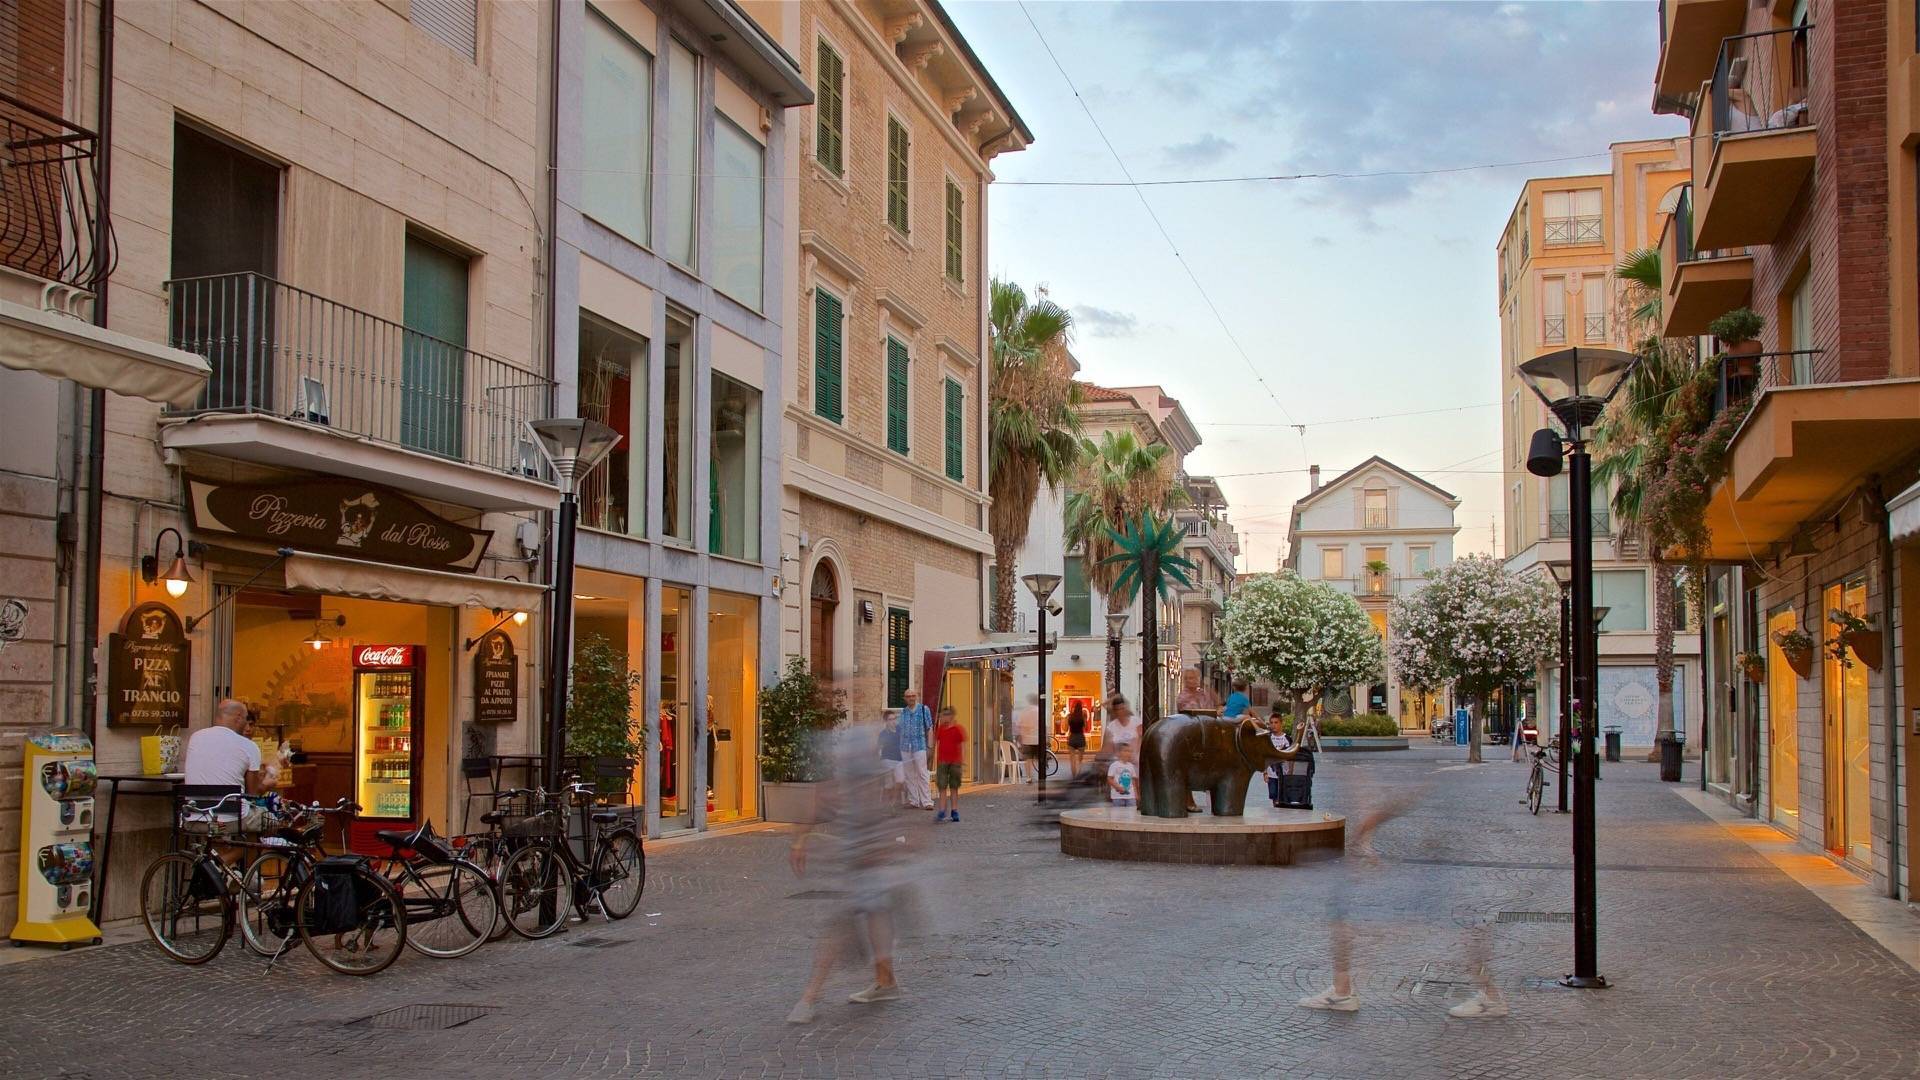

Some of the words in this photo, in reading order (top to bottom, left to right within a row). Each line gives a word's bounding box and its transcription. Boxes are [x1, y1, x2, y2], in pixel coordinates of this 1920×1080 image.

[249, 494, 327, 535] Pizzeria
[381, 524, 403, 544] dal
[407, 522, 450, 551] Rosso
[134, 658, 171, 671] PIZZA
[144, 674, 161, 688] AL
[123, 689, 180, 703] TRANCIO
